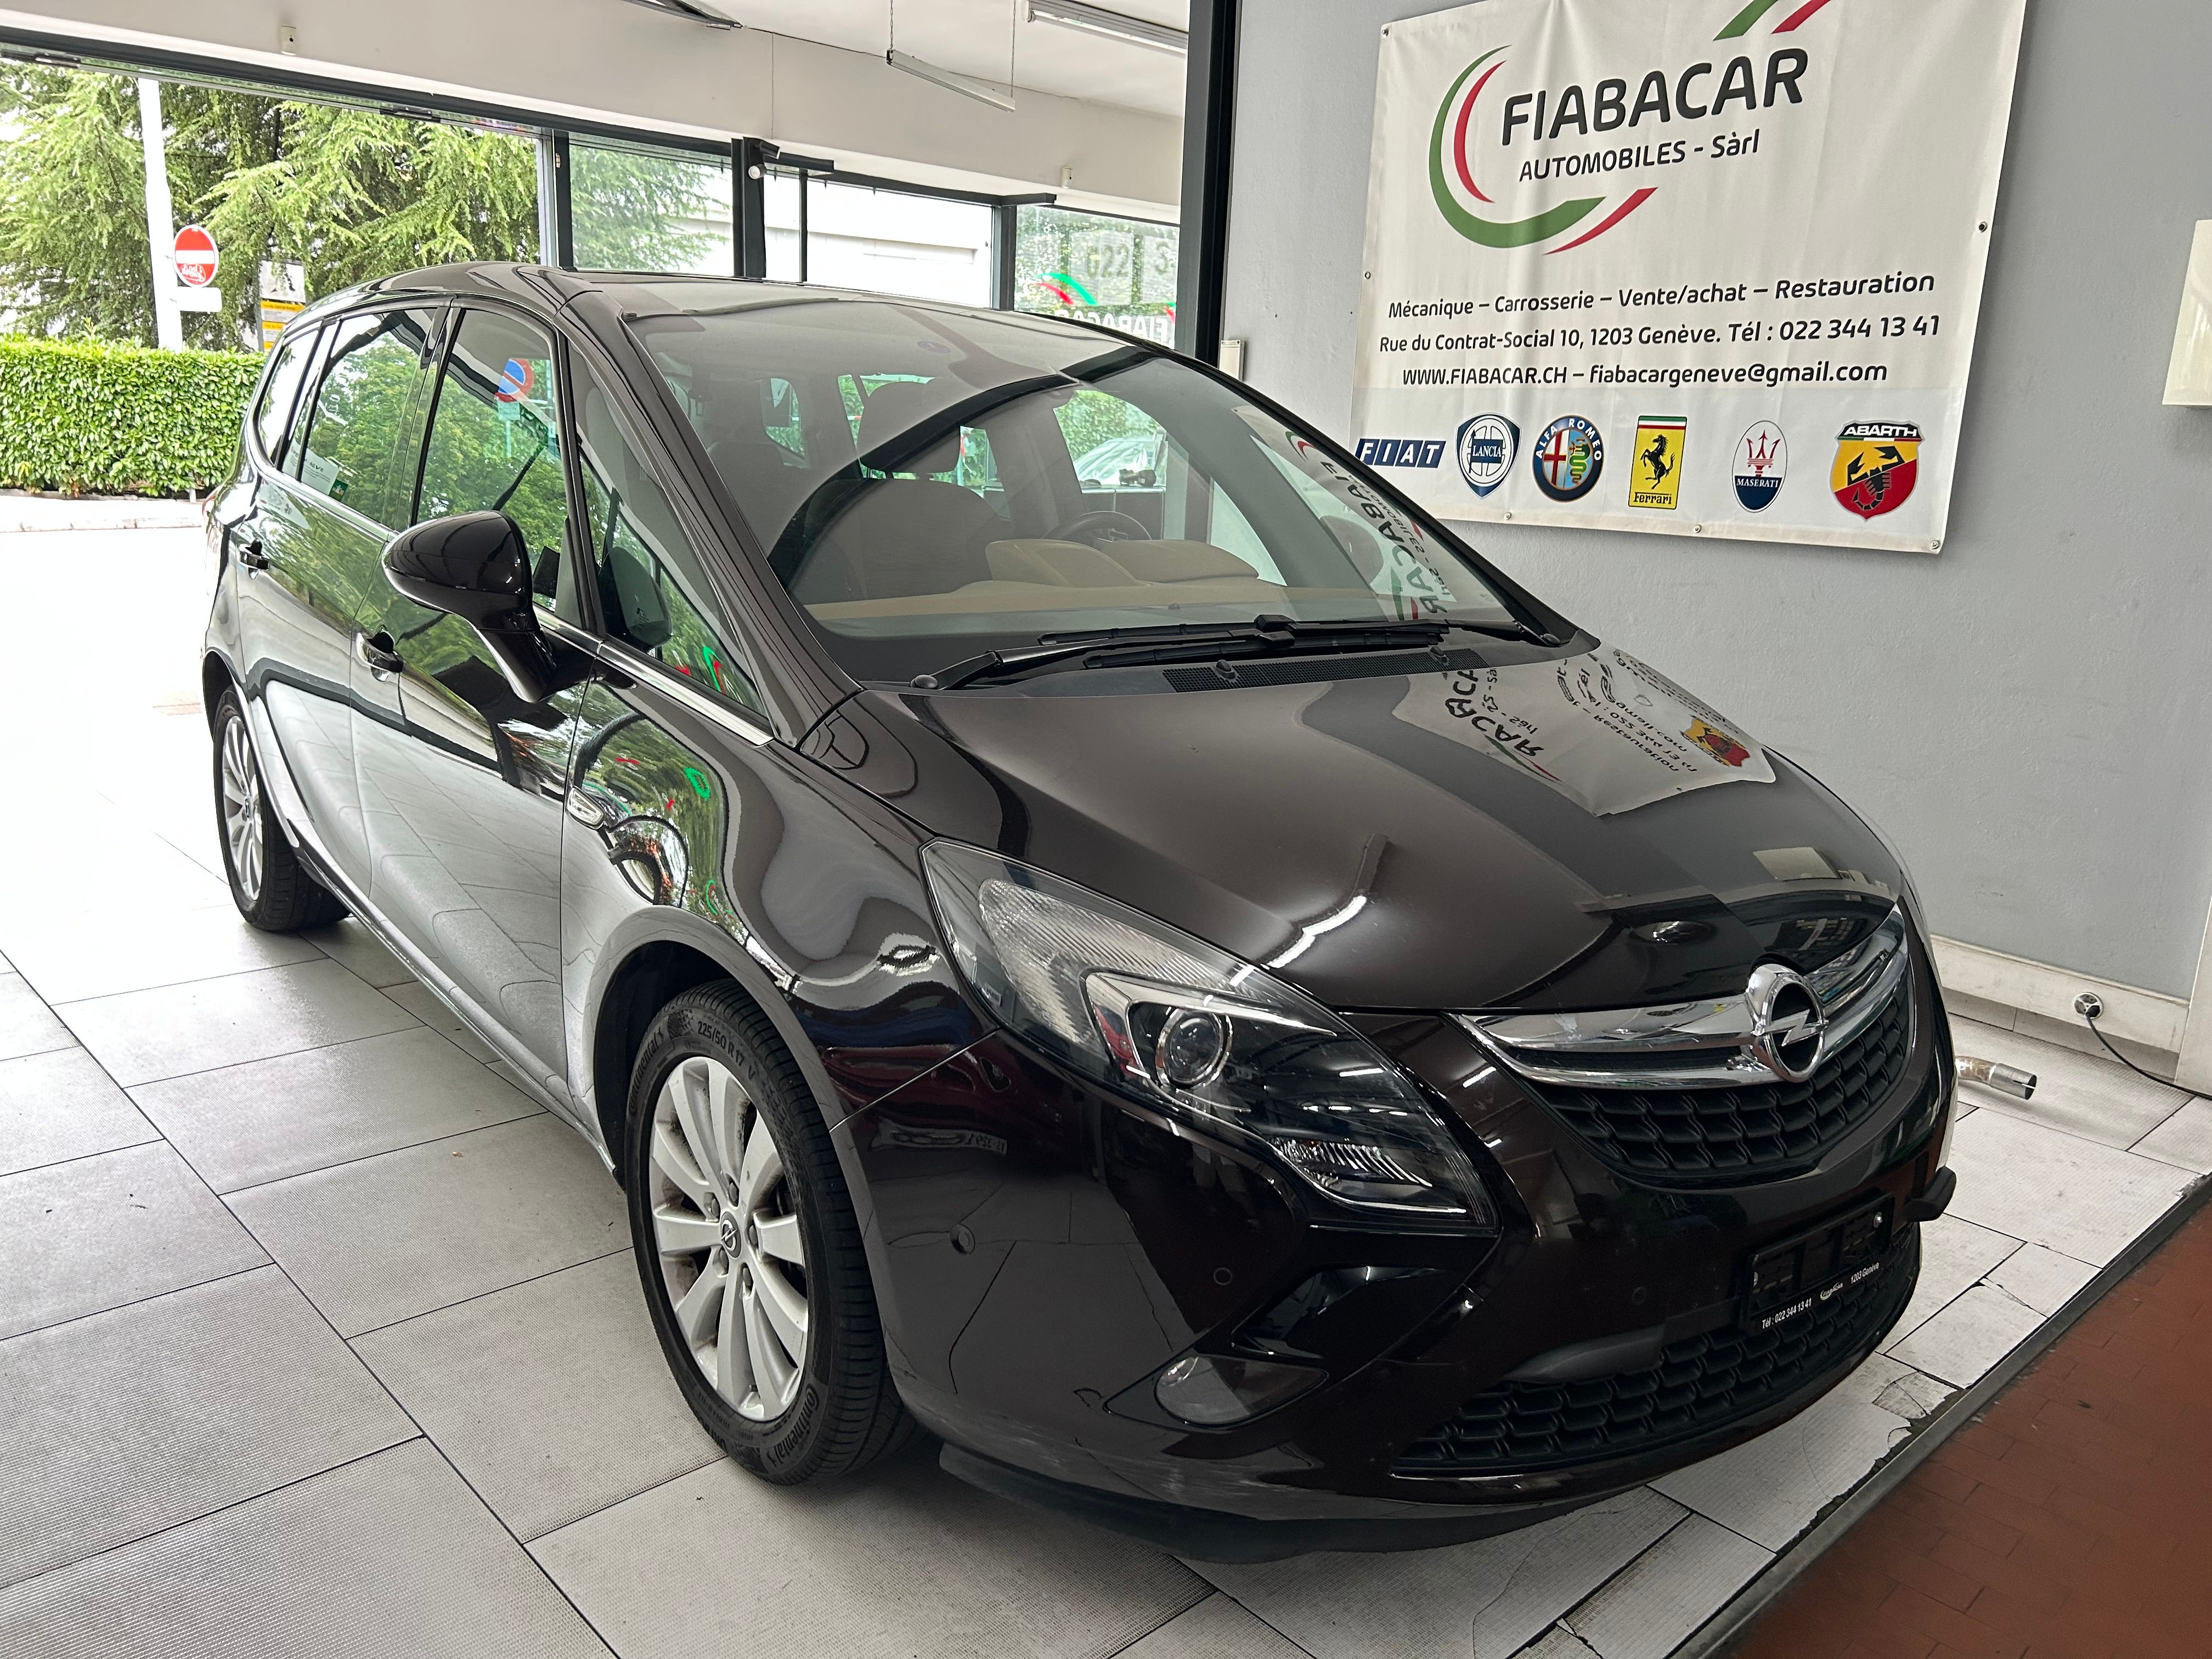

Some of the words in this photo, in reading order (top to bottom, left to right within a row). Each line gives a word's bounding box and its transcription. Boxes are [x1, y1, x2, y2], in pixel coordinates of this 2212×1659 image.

[1502, 48, 1809, 146] FIABACAR
[1519, 140, 1686, 182] AUTOMOBILES
[1711, 128, 1760, 159] Sàrl
[1389, 298, 1474, 320] Mécanique
[1495, 290, 1594, 313] Carrosserie
[1619, 283, 1747, 307] Vente/achat
[1775, 270, 1934, 299] Restauration
[1380, 337, 1407, 352] Rue
[1412, 334, 1431, 351] du
[1435, 329, 1555, 350] Contrat-Social
[1560, 329, 1584, 349] 10,
[1590, 327, 1633, 346] 1203
[1638, 324, 1720, 345] Genève.
[1728, 321, 1761, 342] Tél
[1780, 320, 1821, 341] 022
[1827, 318, 1871, 339] 344
[1881, 317, 1906, 337] 13
[1912, 315, 1939, 336] 41
[1403, 366, 1567, 385] WWW.FIABACAR.CH
[1590, 360, 1887, 388] fiabacargeneve@gmail.com
[1536, 425, 1558, 459] ALFA
[1568, 417, 1602, 461] ROMEO
[1844, 424, 1917, 438] ABARTH
[1359, 441, 1440, 464] FIAT
[1472, 444, 1502, 458] LANCIA
[1633, 492, 1672, 505] Ferrari
[1736, 477, 1779, 488] MASERATI
[1775, 1310, 1786, 1323] 022
[1786, 1305, 1797, 1318] 344
[1851, 1270, 1862, 1284] 1203
